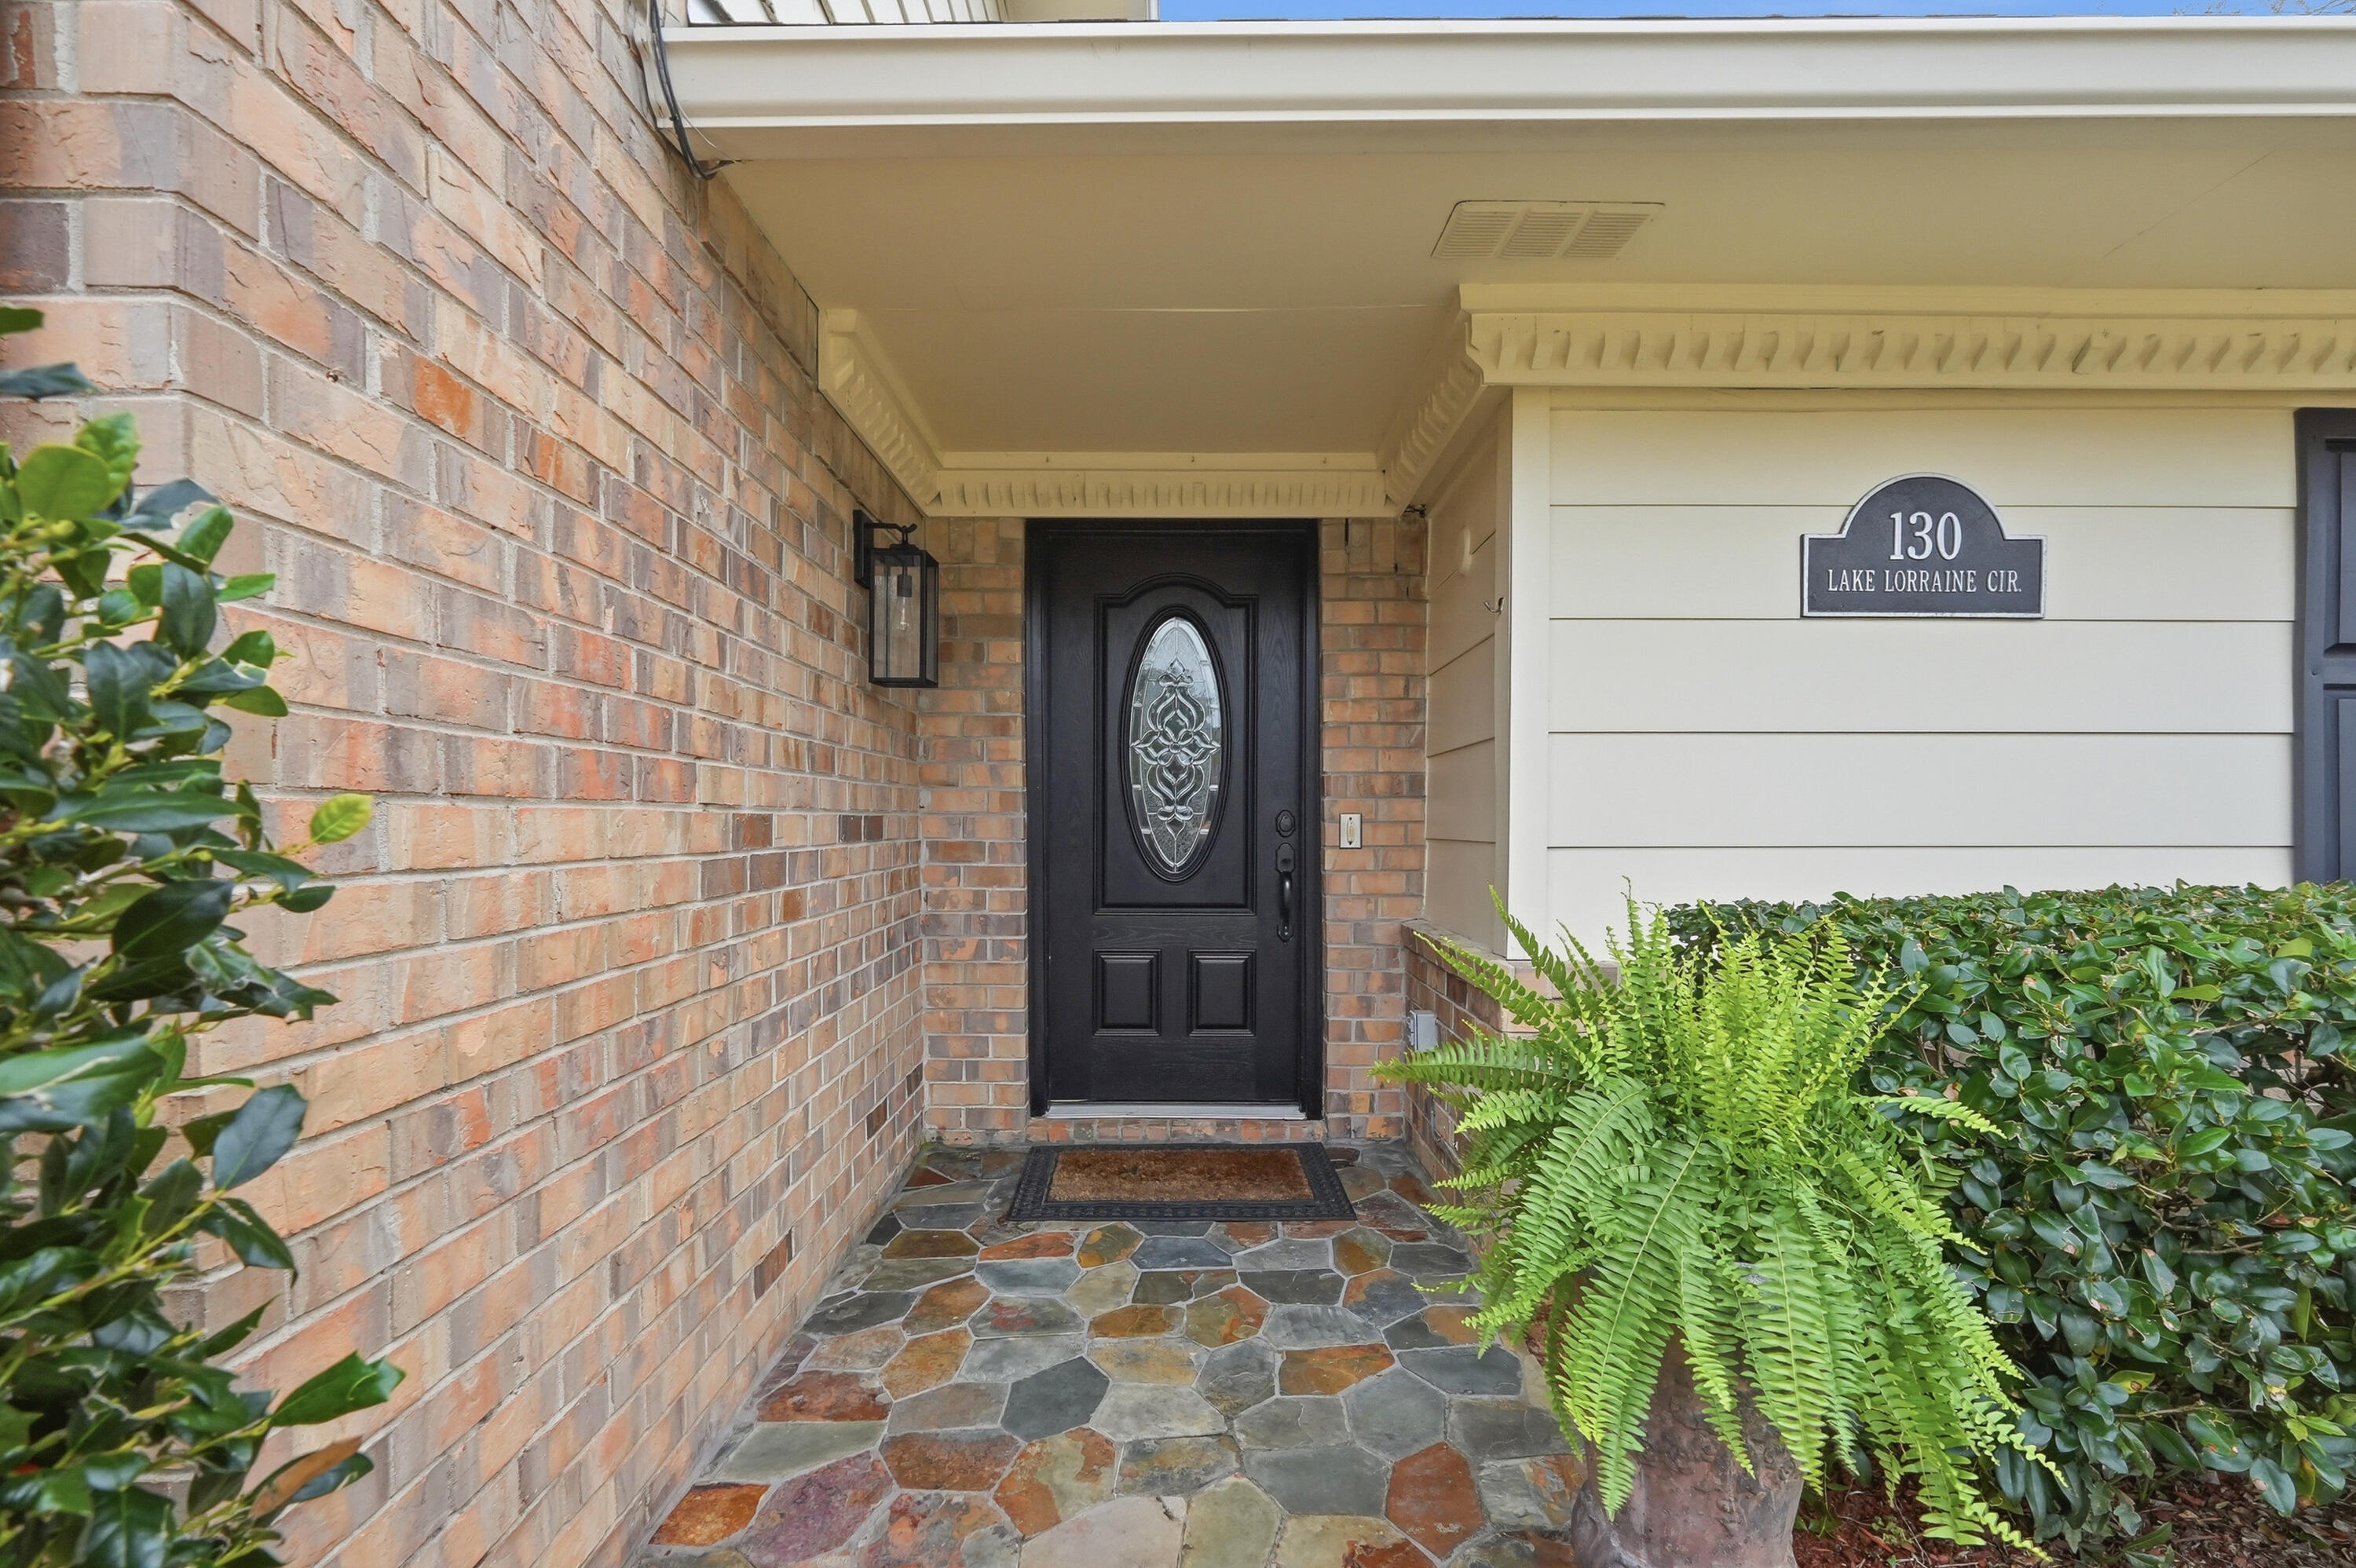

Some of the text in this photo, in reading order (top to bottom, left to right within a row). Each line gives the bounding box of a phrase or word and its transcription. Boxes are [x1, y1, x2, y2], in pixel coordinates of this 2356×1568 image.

[1889, 510, 1962, 561] 130
[1827, 569, 2022, 593] LAKE LORRAINE CIR.
